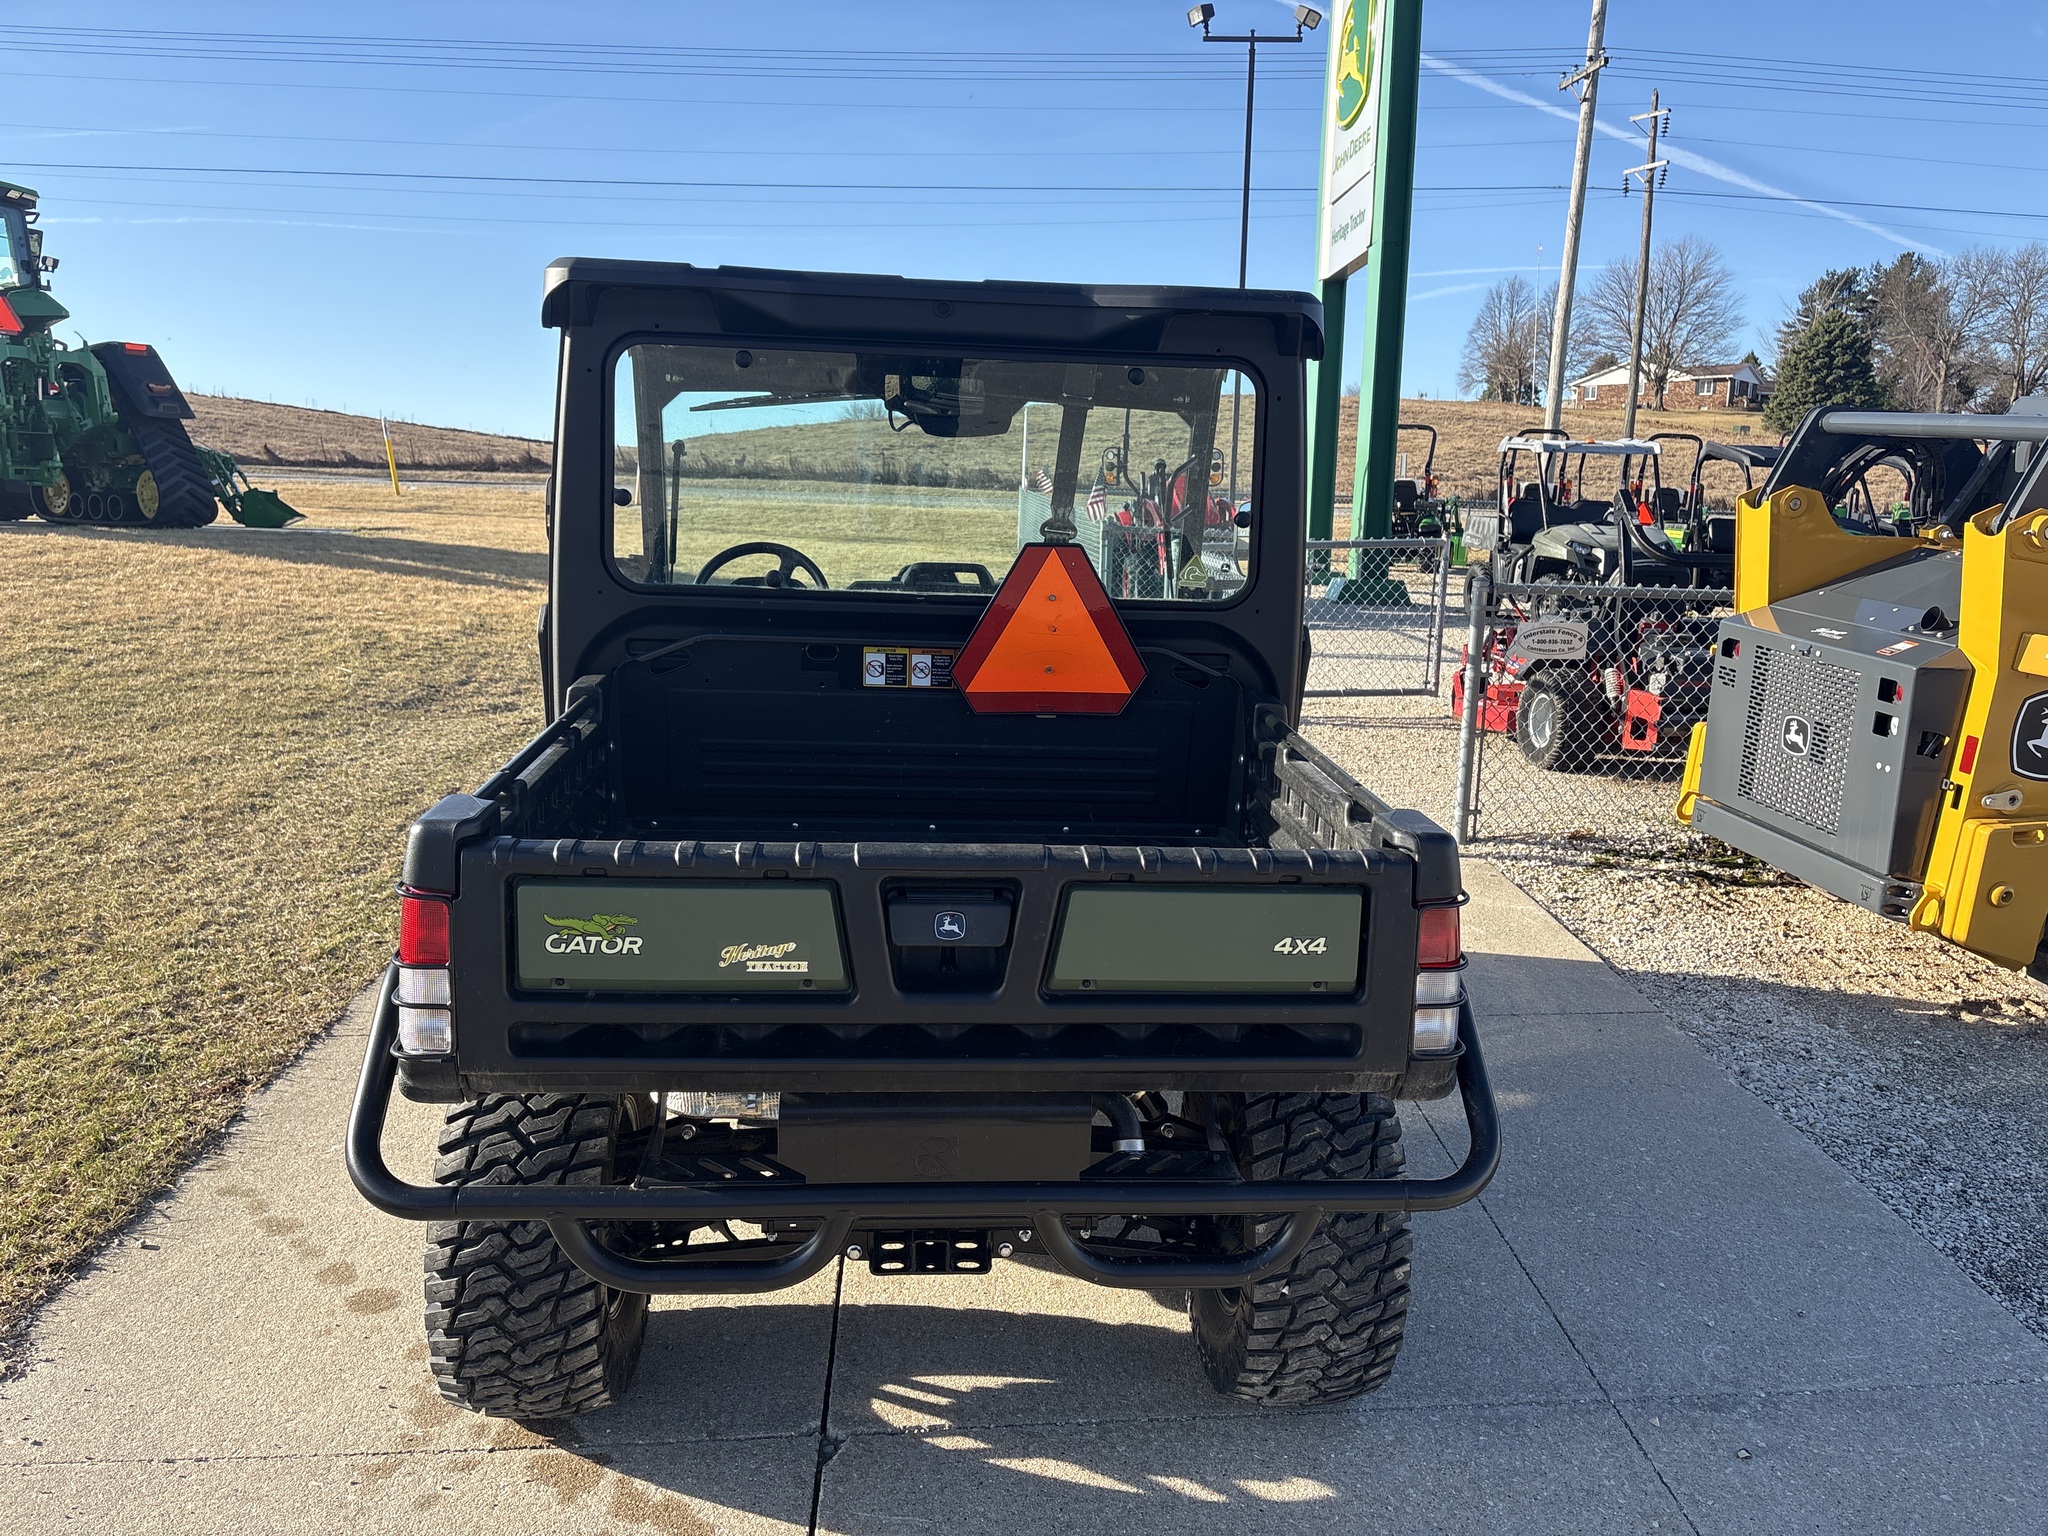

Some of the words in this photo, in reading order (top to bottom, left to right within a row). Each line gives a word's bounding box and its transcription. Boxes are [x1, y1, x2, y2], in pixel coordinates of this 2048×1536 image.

[1332, 147, 1349, 175] JOHN
[1350, 126, 1371, 160] DEERE
[1331, 222, 1349, 247] Heritage
[1350, 209, 1366, 232] Tractor
[1523, 628, 1556, 640] Interstate
[1558, 628, 1578, 639] Fence
[1526, 645, 1557, 653] Construction
[545, 934, 643, 954] GATOR
[719, 942, 797, 968] Heritage
[746, 961, 809, 972] TRACTOR
